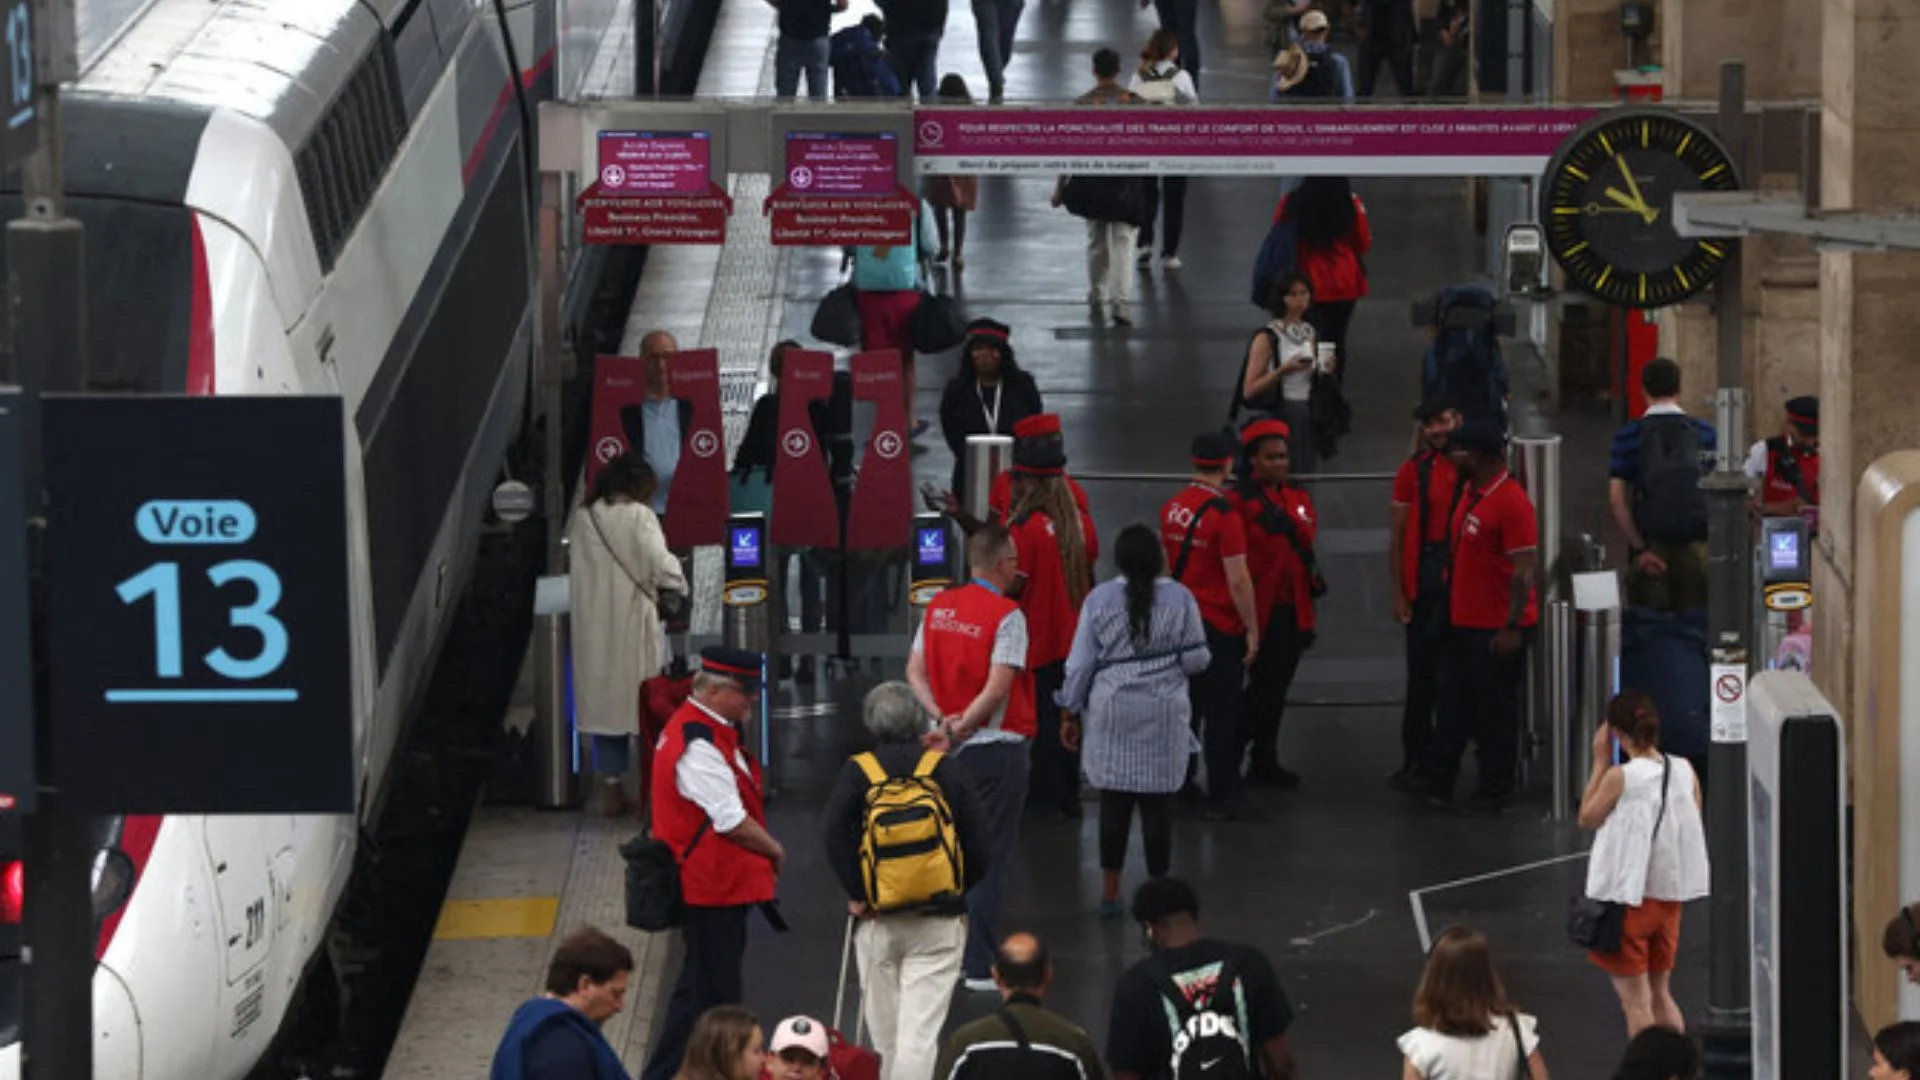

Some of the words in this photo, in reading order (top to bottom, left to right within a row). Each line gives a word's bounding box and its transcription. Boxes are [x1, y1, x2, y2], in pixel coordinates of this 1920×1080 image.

[958, 123, 986, 133] POUR
[988, 123, 1041, 133] RESPECTER
[1042, 123, 1056, 133] LA
[1125, 123, 1145, 133] DES
[1147, 123, 1181, 133] TRAINS
[1183, 123, 1196, 133] ET
[1197, 123, 1210, 133] LE
[1212, 123, 1259, 133] CONFORT
[1260, 123, 1274, 133] DE
[1401, 123, 1419, 133] EST
[1456, 123, 1499, 133] MINUTES
[1501, 123, 1537, 133] AVANT
[1538, 123, 1549, 133] LE
[607, 212, 652, 223] Business
[796, 214, 837, 225] Business
[152, 507, 239, 538] Voie
[116, 559, 289, 680] 13
